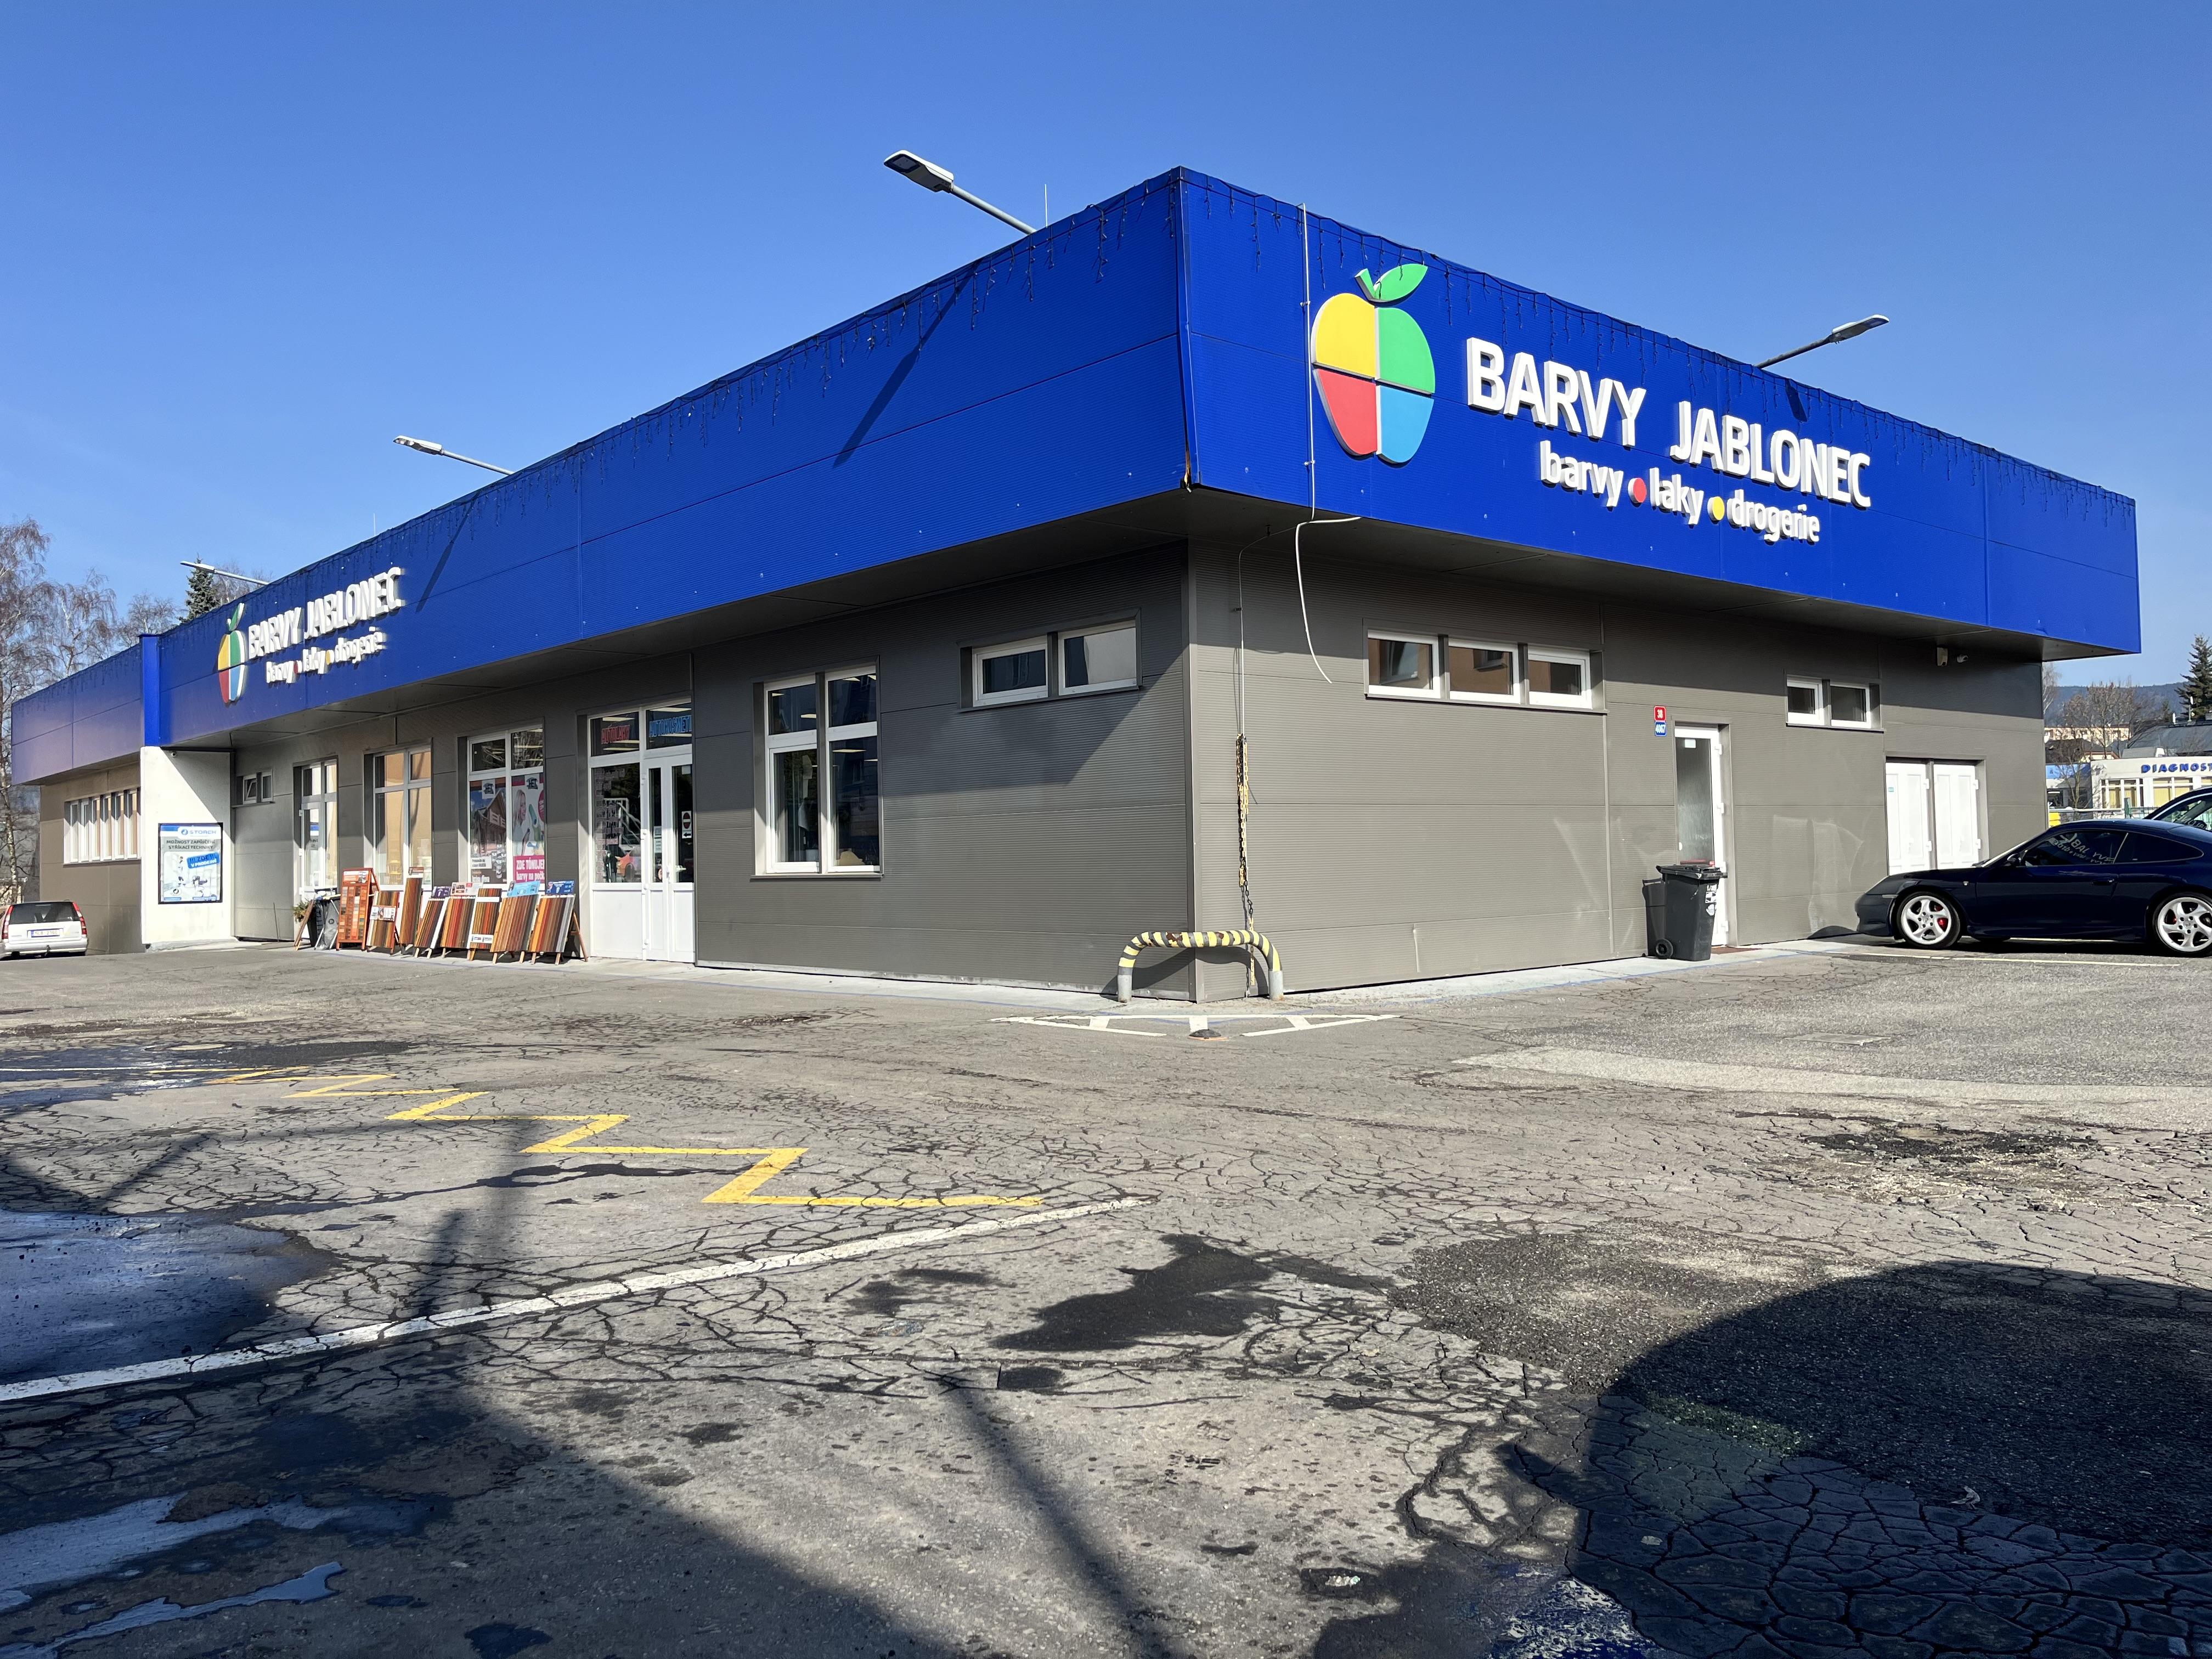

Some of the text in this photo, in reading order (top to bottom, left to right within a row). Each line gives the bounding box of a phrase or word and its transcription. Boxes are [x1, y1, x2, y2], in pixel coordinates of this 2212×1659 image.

[1466, 337, 1871, 508] BARVY JABLONEC
[1540, 440, 1820, 543] barvy laky drogerie
[249, 567, 402, 659] BARVY JABLONEC
[266, 626, 383, 684] barvy laky drogerie
[1657, 709, 1663, 719] 38
[601, 724, 630, 744] AUTOLAKY
[516, 860, 525, 870] ZDE
[516, 871, 528, 882] barvy
